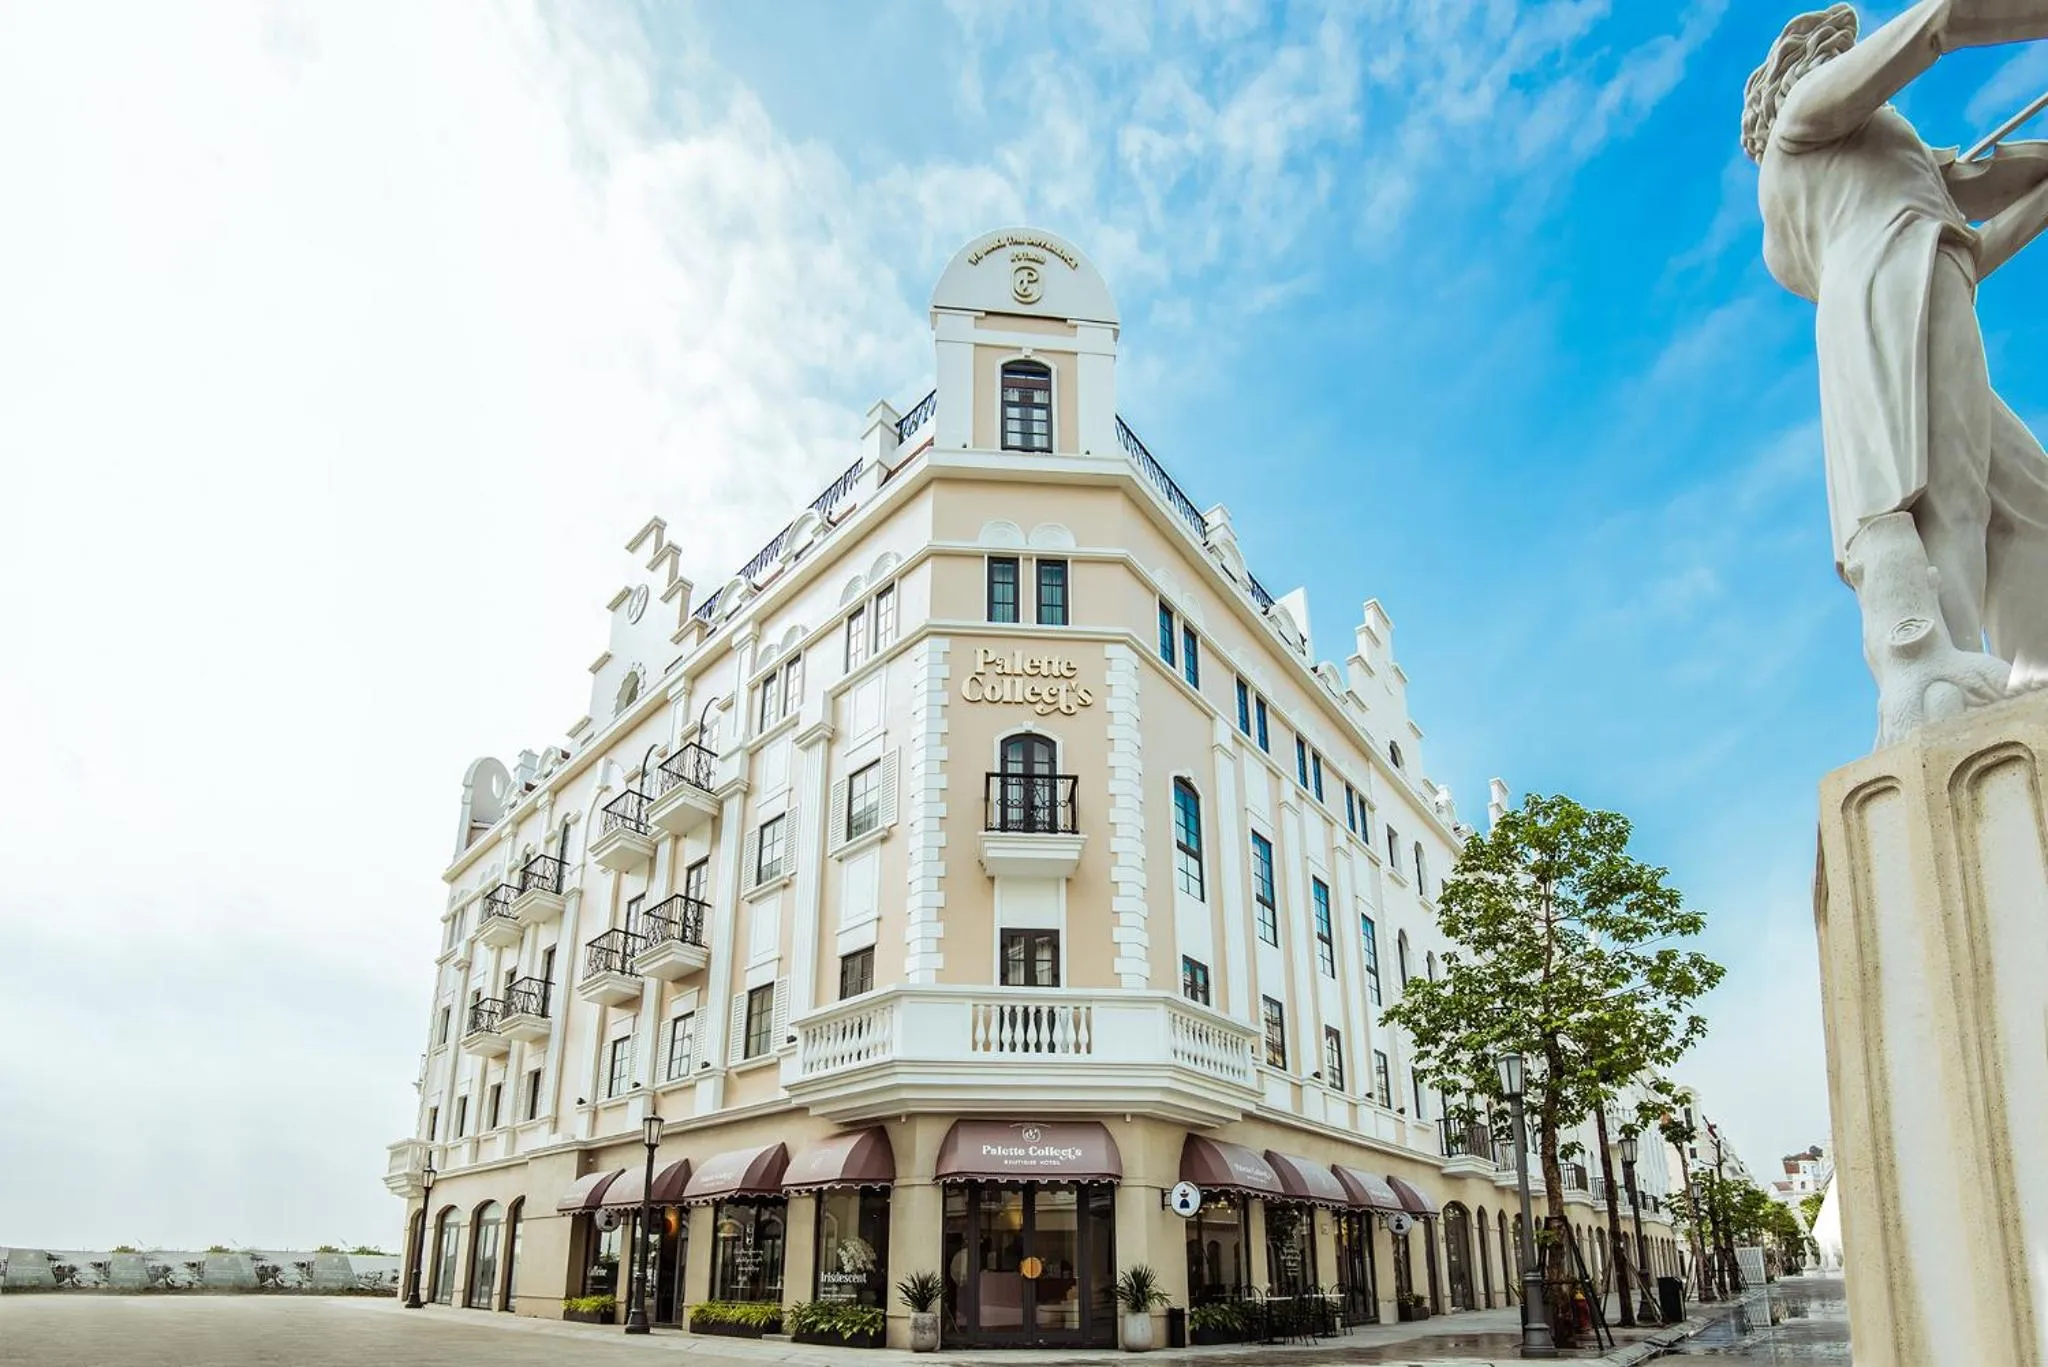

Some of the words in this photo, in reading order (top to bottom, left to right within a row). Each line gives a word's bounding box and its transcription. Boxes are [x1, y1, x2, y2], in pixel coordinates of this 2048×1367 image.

[974, 647, 1077, 678] Palette
[961, 675, 1093, 715] Collect's
[982, 1145, 1025, 1156] Palette
[1029, 1145, 1082, 1160] Collect's
